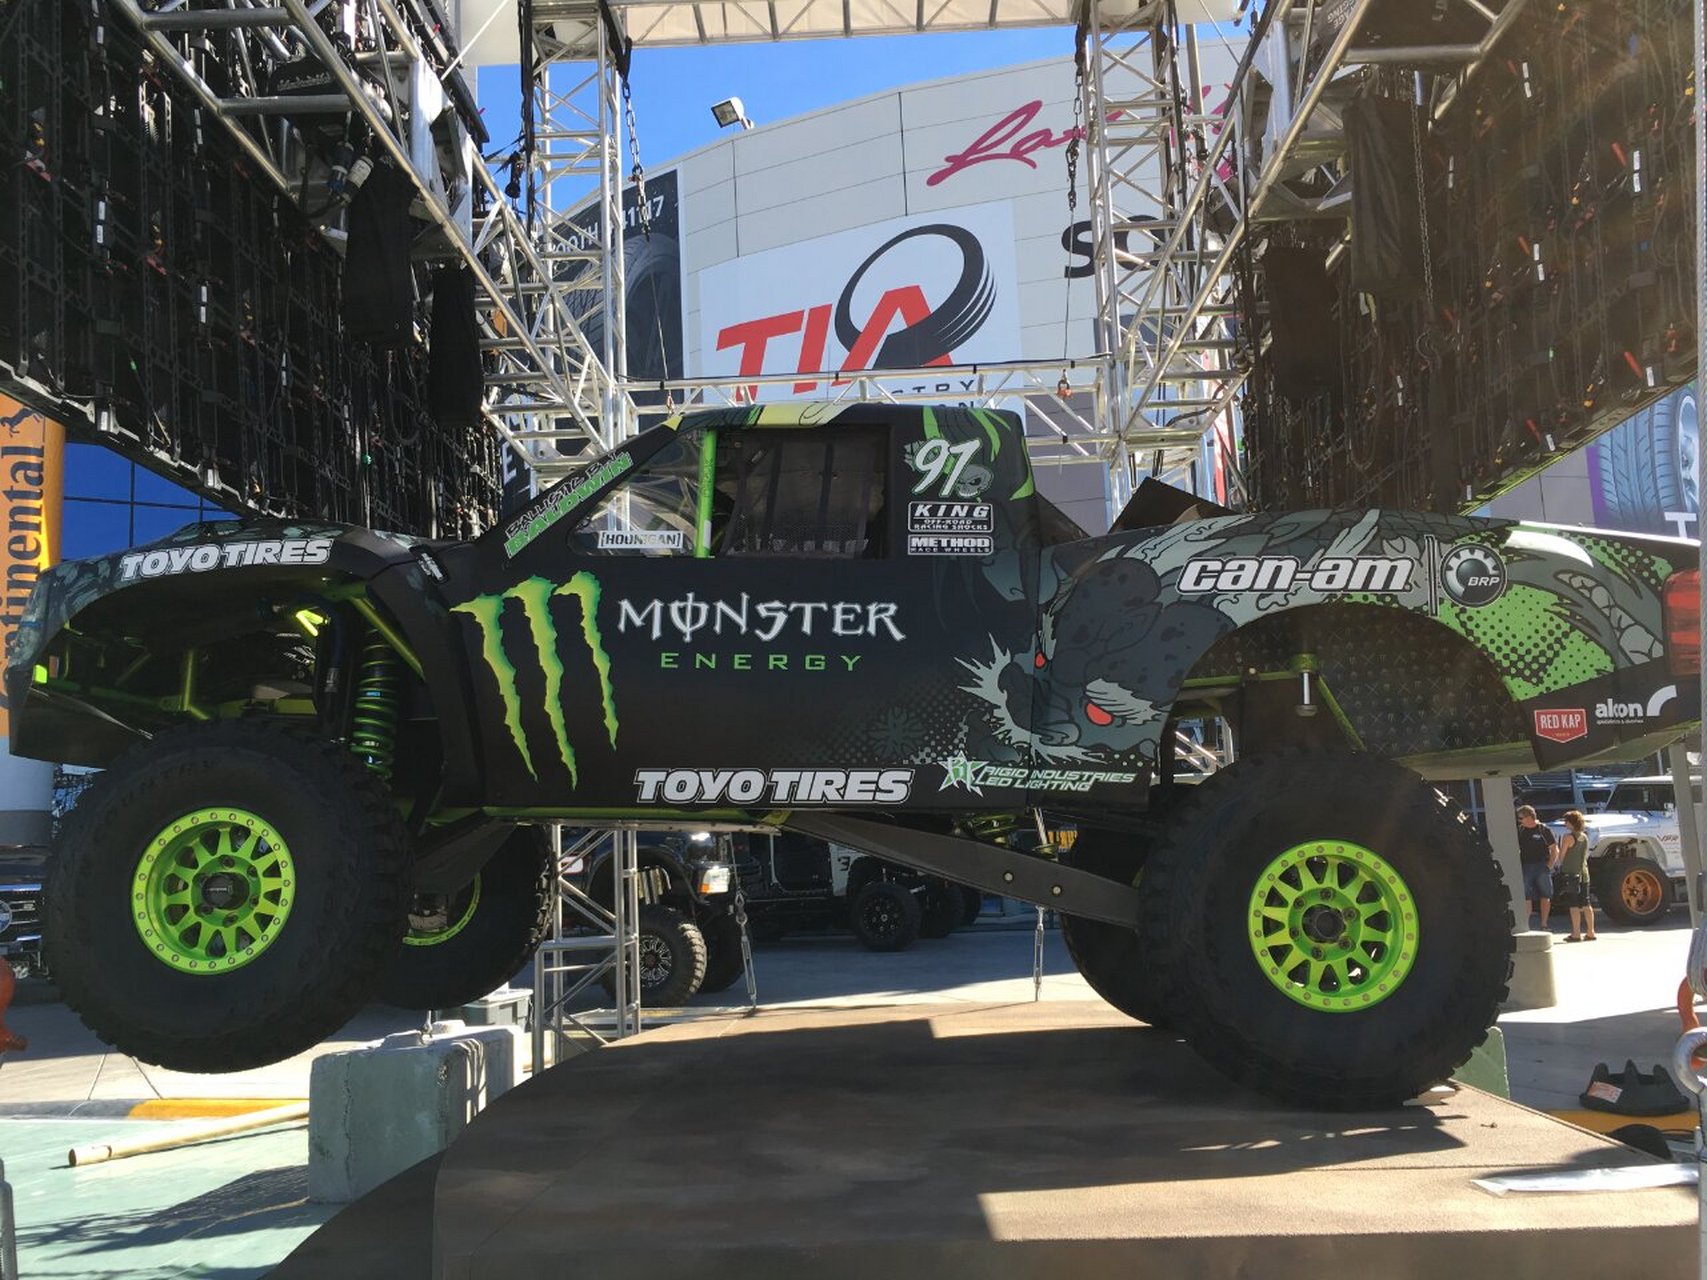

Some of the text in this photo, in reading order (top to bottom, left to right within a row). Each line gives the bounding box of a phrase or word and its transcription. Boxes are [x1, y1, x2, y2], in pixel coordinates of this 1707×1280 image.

[716, 285, 954, 401] TIA
[504, 451, 634, 558] BALDWIN
[914, 504, 990, 518] KING
[911, 537, 990, 548] METHOD
[120, 539, 334, 581] TOYO TIRES
[1177, 556, 1414, 594] can-am
[1468, 576, 1500, 587] BRP
[617, 592, 906, 642] MONSTER
[661, 652, 862, 671] ENERGY
[1595, 698, 1644, 718] akon
[1540, 713, 1581, 729] RED KAP
[973, 776, 1093, 792] LED LIGHTING
[982, 766, 1137, 784] RIGID INDUSTRIES
[634, 768, 915, 803] TOYO TIRES
